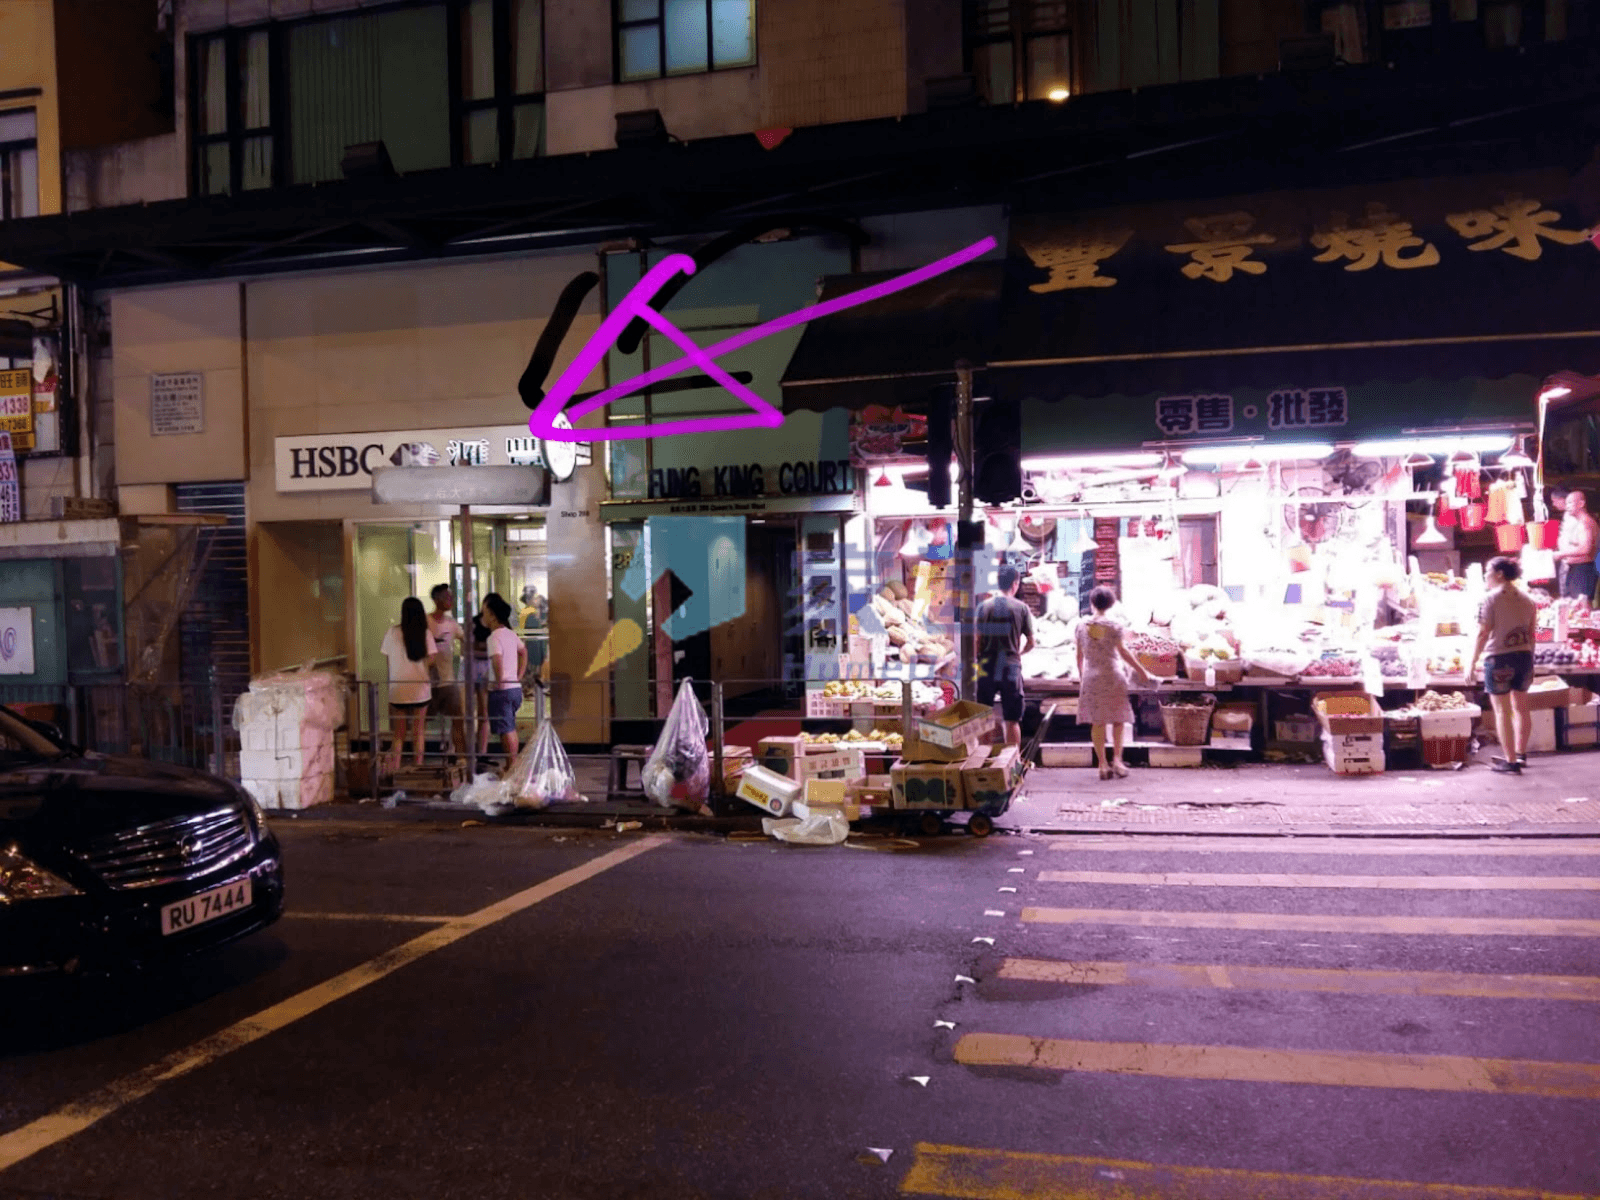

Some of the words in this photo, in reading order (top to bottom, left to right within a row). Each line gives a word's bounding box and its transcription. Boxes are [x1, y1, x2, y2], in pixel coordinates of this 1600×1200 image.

[290, 443, 385, 479] HSBC
[649, 467, 701, 498] FUNG
[715, 464, 764, 496] KING
[779, 460, 851, 494] COURT
[169, 902, 196, 931] RU
[201, 885, 246, 919] 7444
